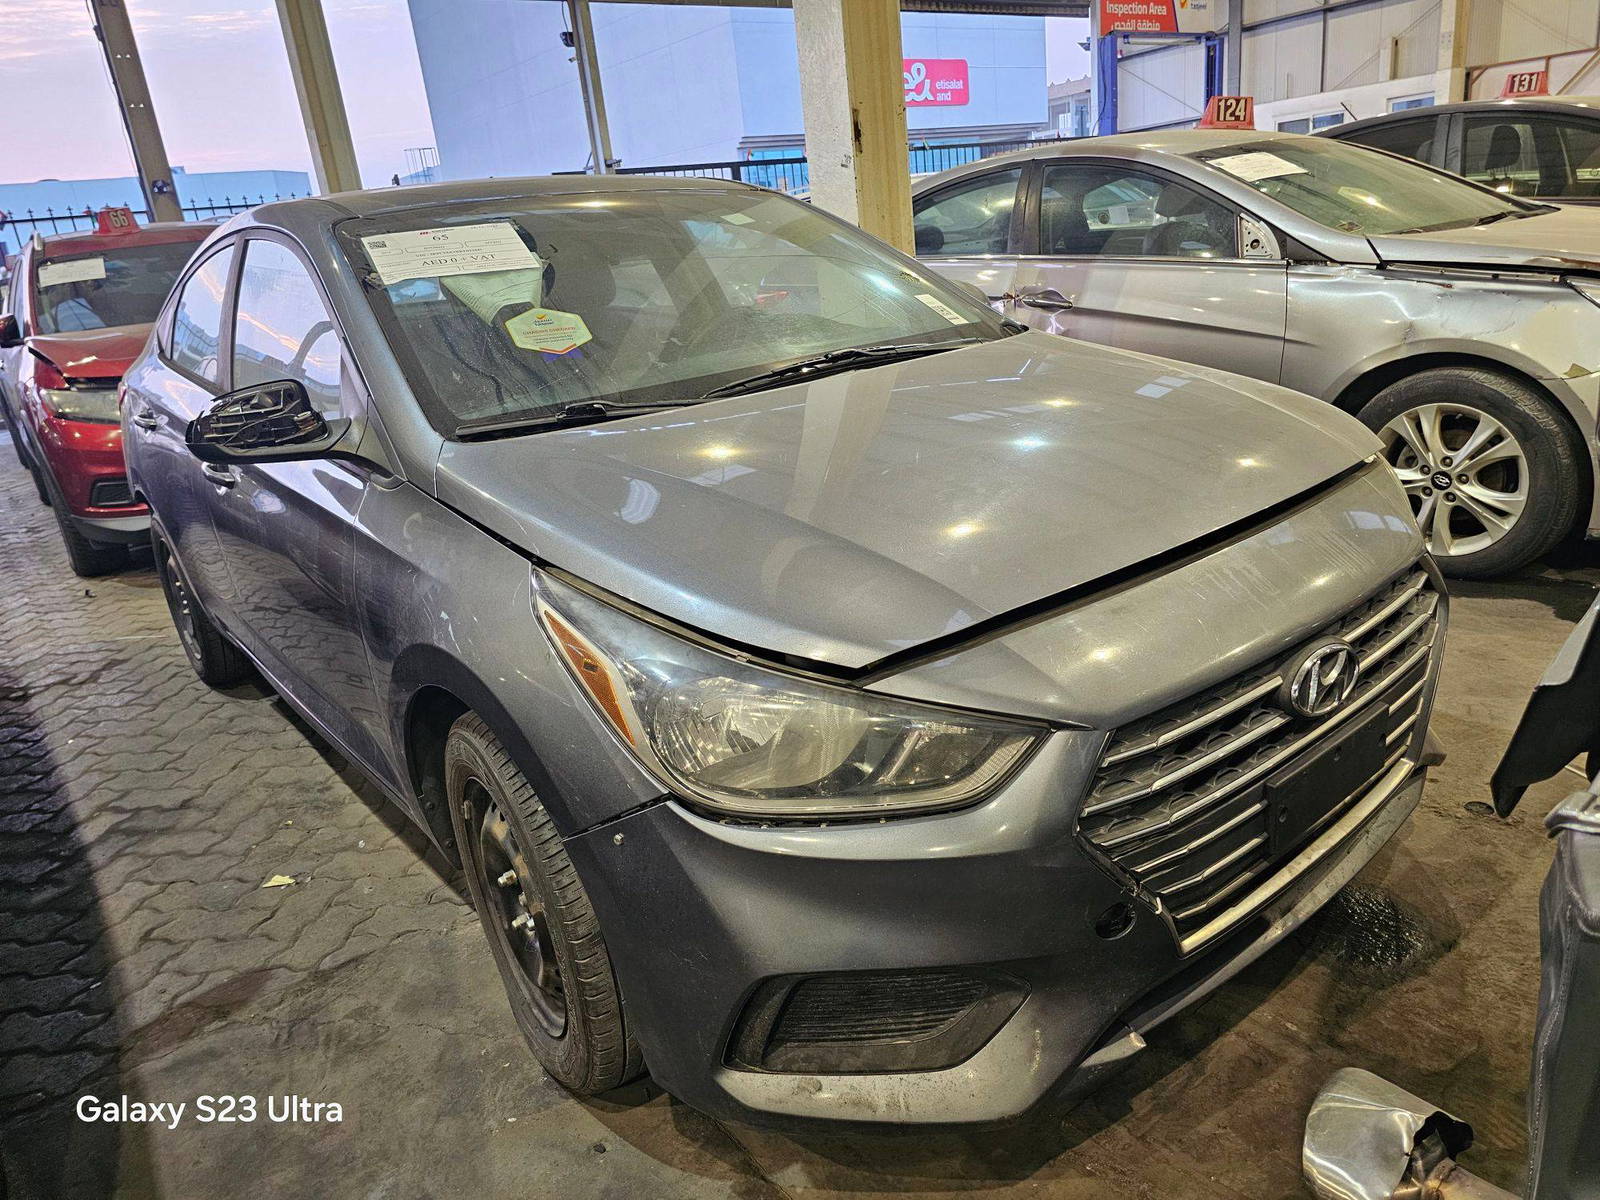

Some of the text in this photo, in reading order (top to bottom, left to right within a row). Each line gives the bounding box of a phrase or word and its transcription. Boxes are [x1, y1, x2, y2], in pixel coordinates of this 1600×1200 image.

[1107, 2, 1167, 17] Inspection Area
[1137, 19, 1160, 31] منطقة
[936, 79, 963, 90] etisalat
[1513, 73, 1538, 93] 131
[936, 91, 951, 101] and
[1218, 98, 1246, 121] 124
[109, 211, 129, 228] 66
[422, 258, 447, 267] AED
[470, 253, 496, 262] VAT
